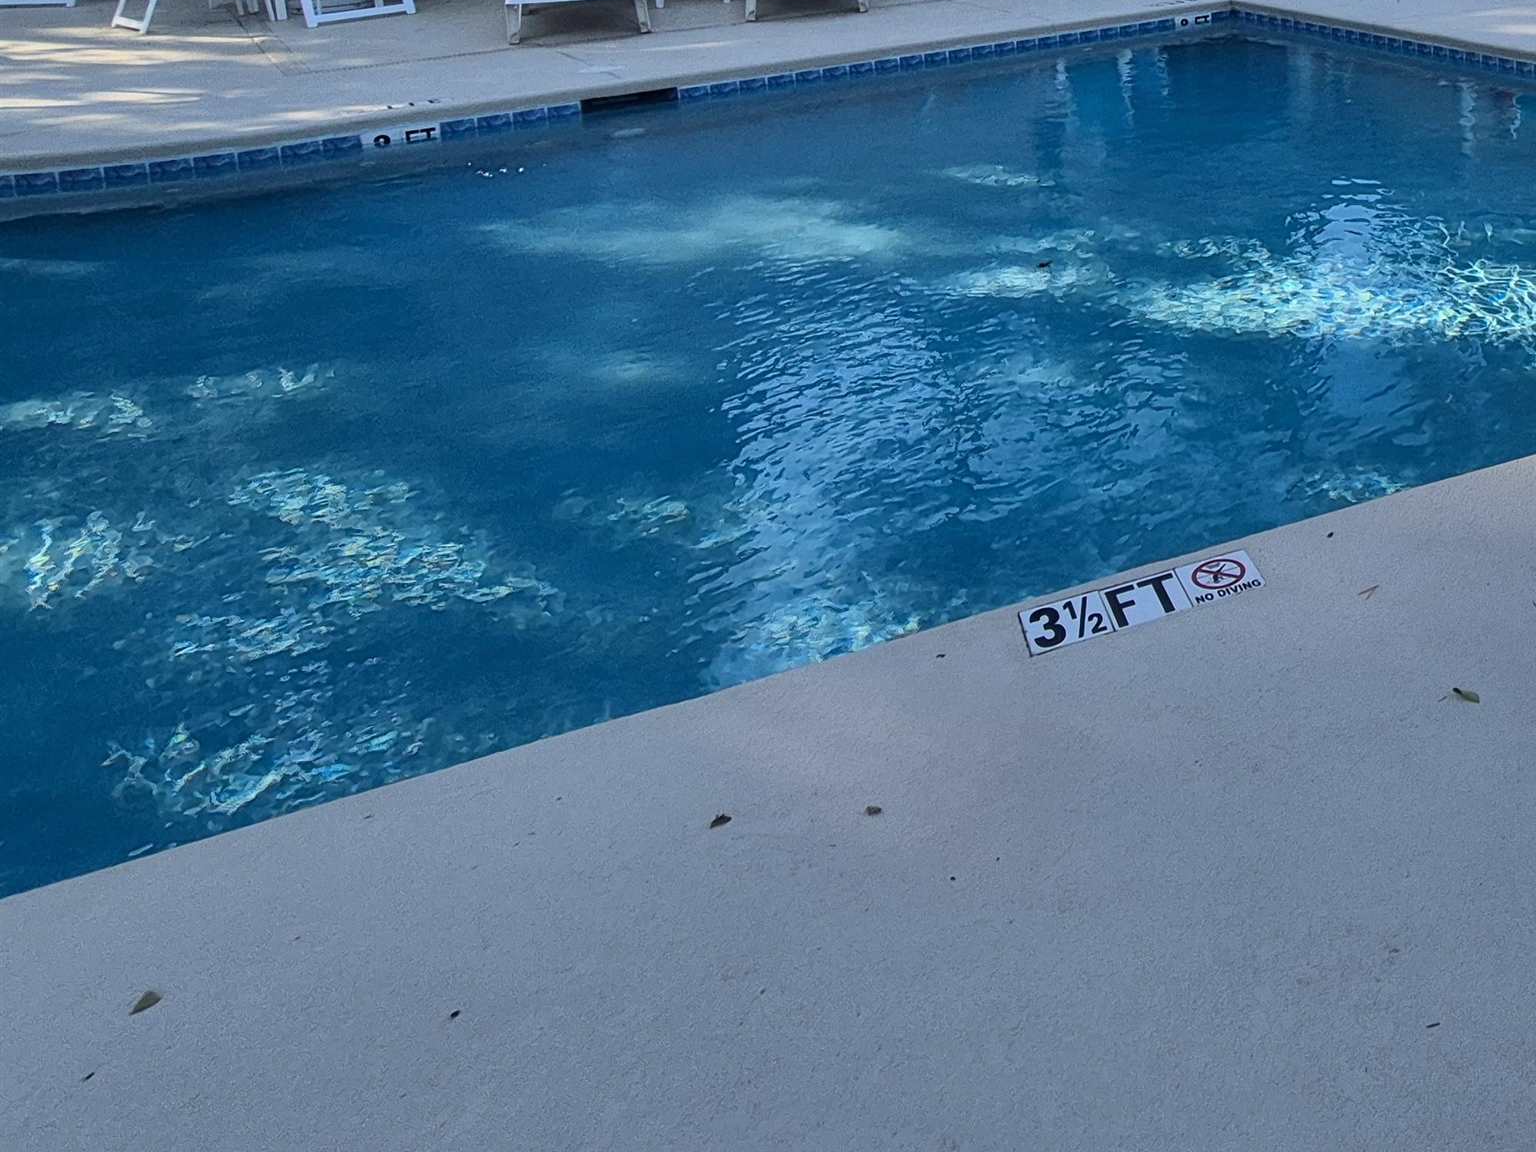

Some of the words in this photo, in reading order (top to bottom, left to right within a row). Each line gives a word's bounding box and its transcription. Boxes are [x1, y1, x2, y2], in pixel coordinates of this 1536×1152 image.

[1104, 573, 1176, 628] FT
[1195, 592, 1215, 605] NO
[1217, 578, 1262, 598] DIVING
